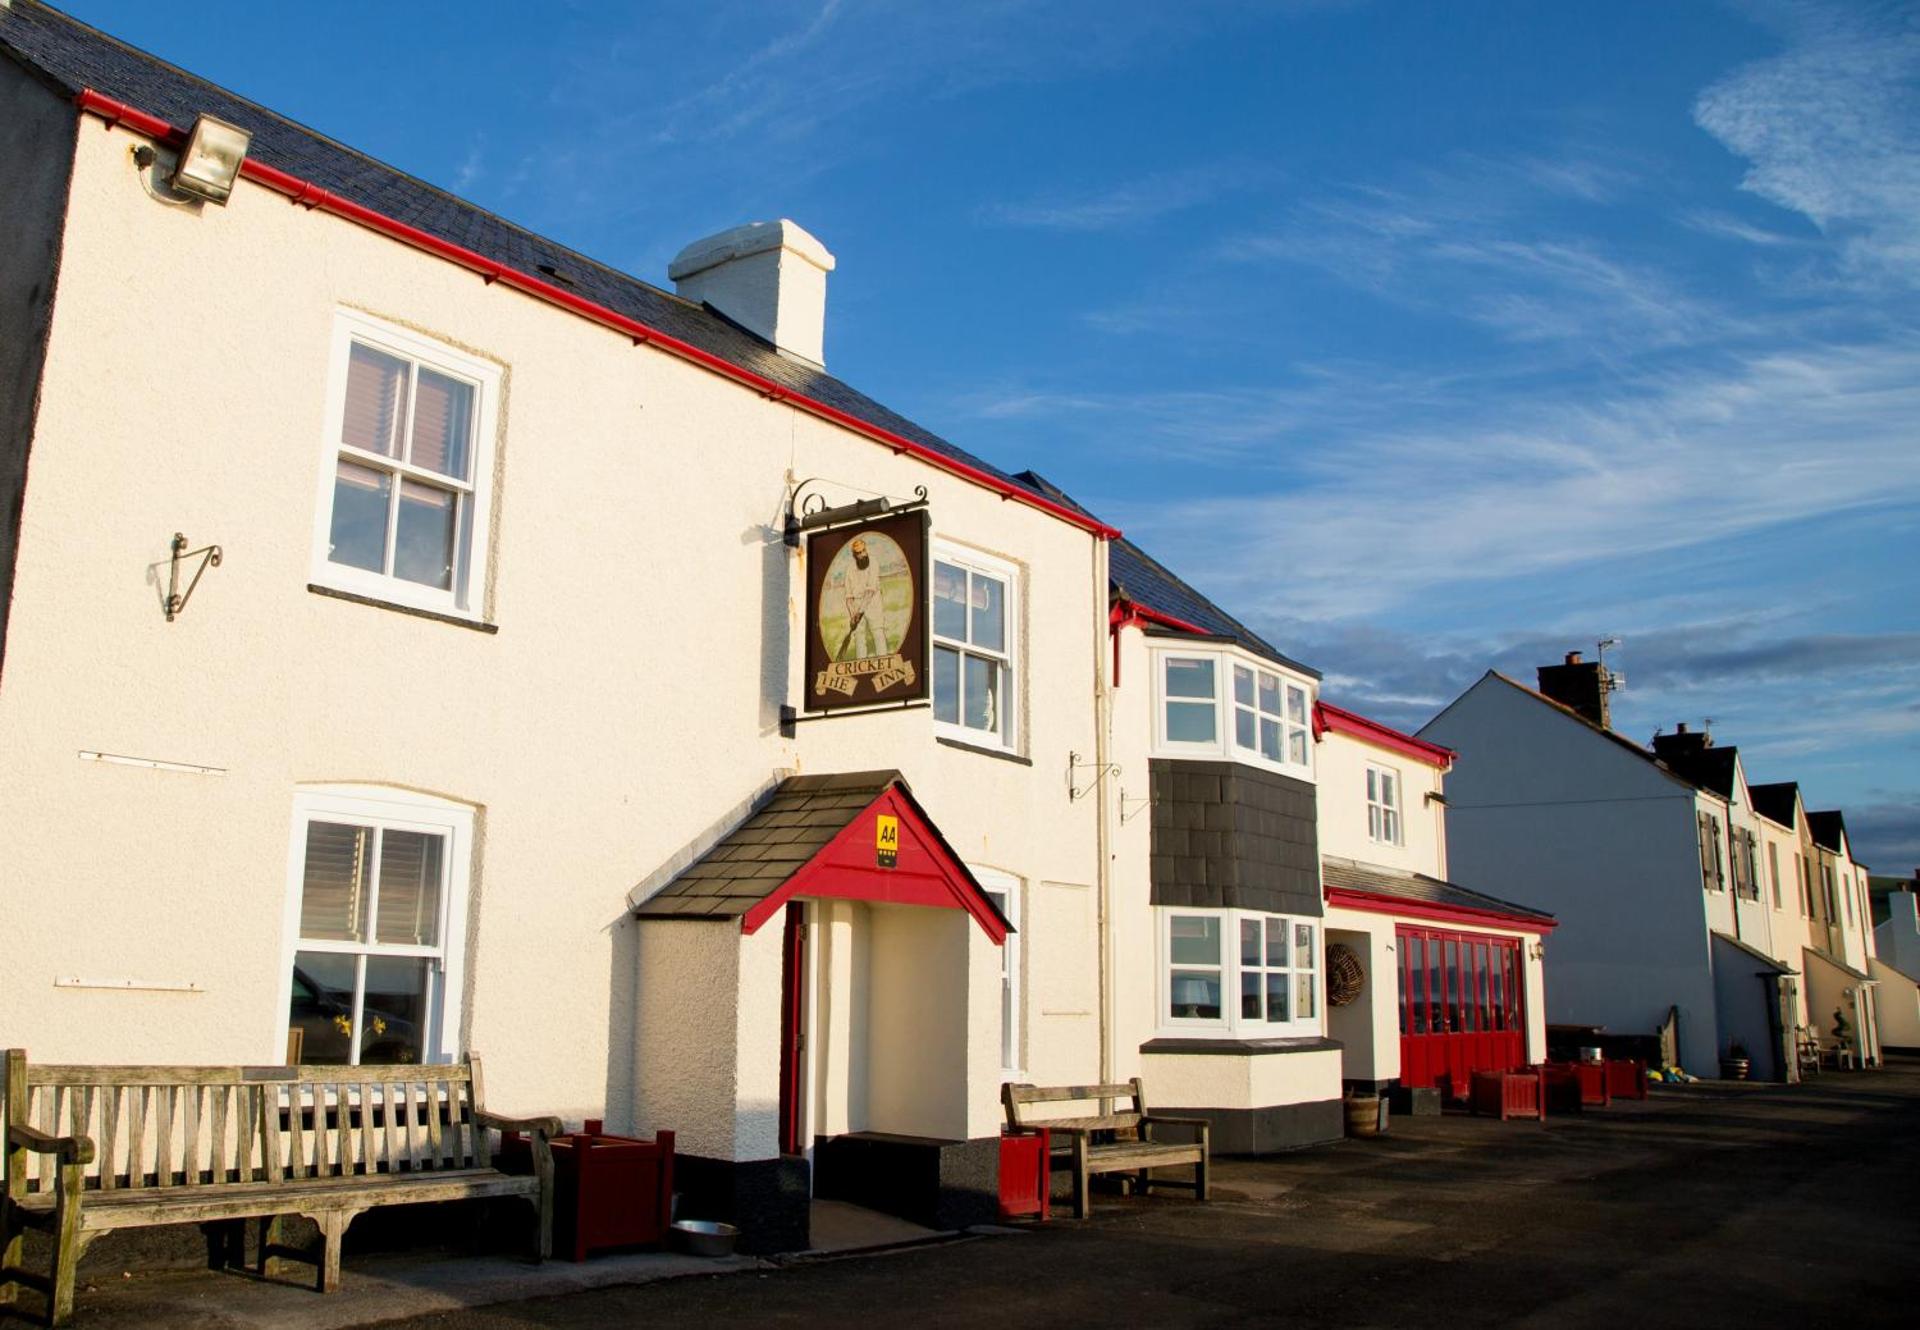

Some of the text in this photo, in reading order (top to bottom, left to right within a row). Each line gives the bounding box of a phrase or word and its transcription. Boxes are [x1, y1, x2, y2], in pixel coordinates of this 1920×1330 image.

[835, 657, 893, 676] CRICKET
[822, 673, 850, 691] THE
[879, 668, 907, 687] INN
[880, 824, 896, 844] AA
